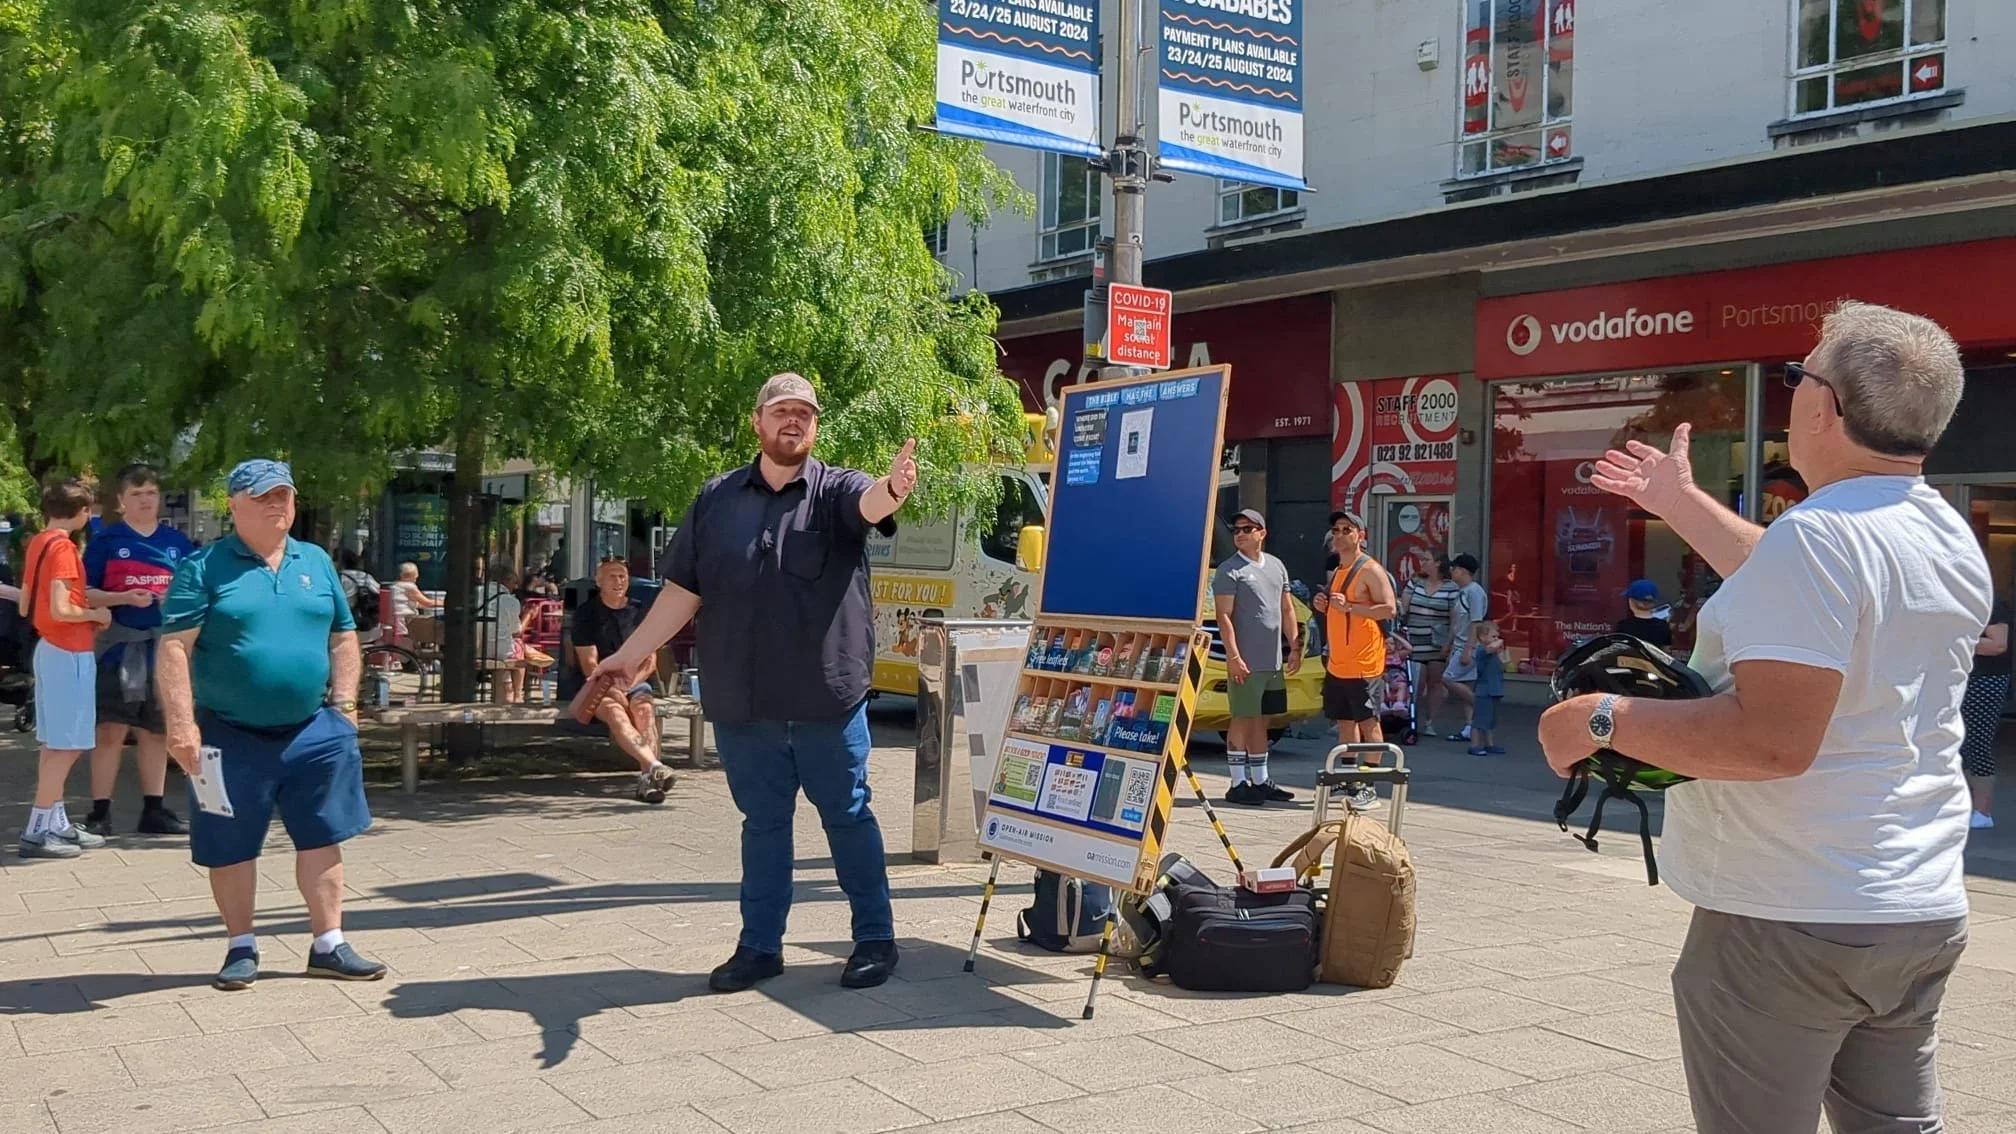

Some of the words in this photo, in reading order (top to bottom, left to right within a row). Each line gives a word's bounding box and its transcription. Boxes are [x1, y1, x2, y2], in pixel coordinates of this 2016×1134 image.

[1038, 0, 1094, 22] AVAILABLE
[951, 3, 1012, 25] 23/24/25
[1013, 11, 1058, 35] AUGUST
[1059, 23, 1089, 42] 2024
[1163, 26, 1211, 49] PAYMENT
[1212, 36, 1245, 55] PLANS
[1246, 43, 1297, 66] AVAILABLE
[1167, 45, 1222, 70] 23/24/25
[1224, 57, 1265, 78] AUGUST
[1266, 66, 1293, 84] 2024
[962, 59, 1076, 106] Portsmouth
[962, 90, 978, 104] the
[981, 95, 1006, 109] great
[1008, 100, 1058, 119] waterfront
[1059, 107, 1075, 122] city
[1179, 102, 1283, 142] Portsmouth
[1180, 130, 1195, 143] the
[1197, 134, 1220, 146] great
[1221, 138, 1266, 154] waterfront
[1268, 144, 1282, 159] city
[1114, 291, 1166, 310] COVID-19
[1550, 307, 1694, 344] vodafone
[1117, 345, 1161, 360] distance
[1162, 383, 1196, 396] ANSWERS
[1377, 395, 1418, 412] STAFF
[1421, 392, 1456, 409] 2000
[1275, 417, 1291, 427] EST.
[1294, 415, 1311, 426] 1971
[1376, 411, 1456, 426] RECRUITMENT
[1377, 446, 1396, 462] 023
[1398, 444, 1412, 461] 92
[1414, 442, 1454, 460] 821488
[891, 582, 913, 601] FOR
[915, 583, 937, 602] YOU
[1114, 726, 1139, 741] Please
[1139, 731, 1160, 744] take!
[1001, 824, 1028, 837] OPEN-AIR
[1029, 831, 1055, 843] MISSION
